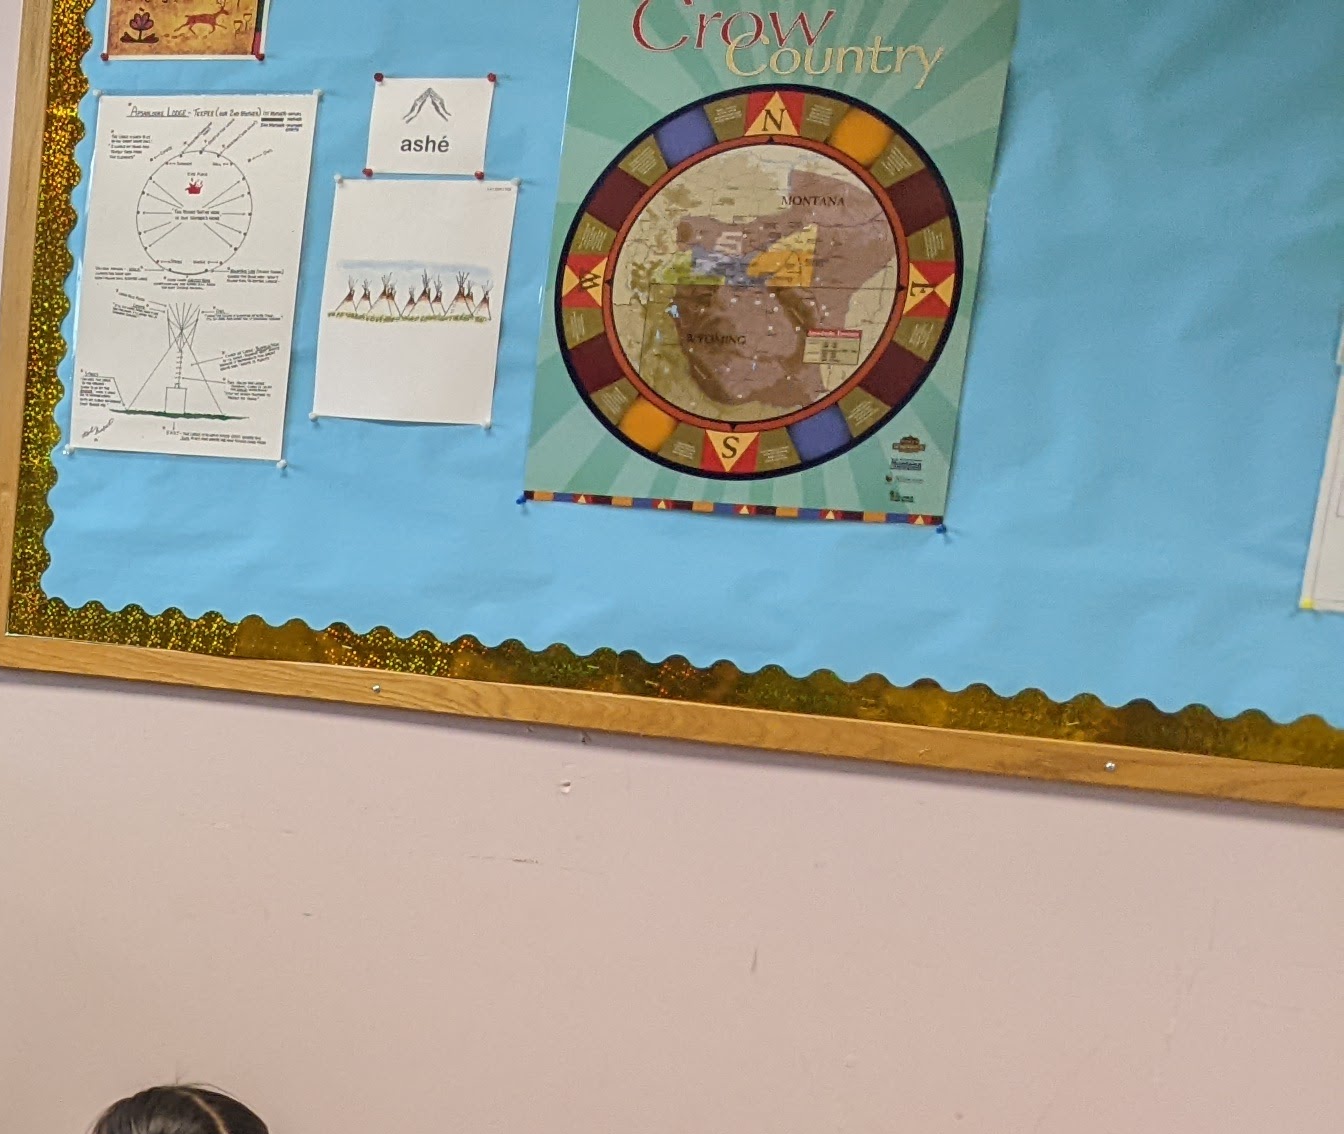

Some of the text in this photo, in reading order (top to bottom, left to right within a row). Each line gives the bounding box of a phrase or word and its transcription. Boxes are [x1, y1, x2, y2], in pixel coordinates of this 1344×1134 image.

[632, 0, 837, 52] Crow
[725, 31, 945, 90] Country
[762, 108, 786, 132] N
[400, 135, 450, 153] ashé
[781, 195, 847, 207] MONTANA
[580, 272, 602, 290] W
[910, 281, 938, 297] E
[722, 436, 740, 459] S
